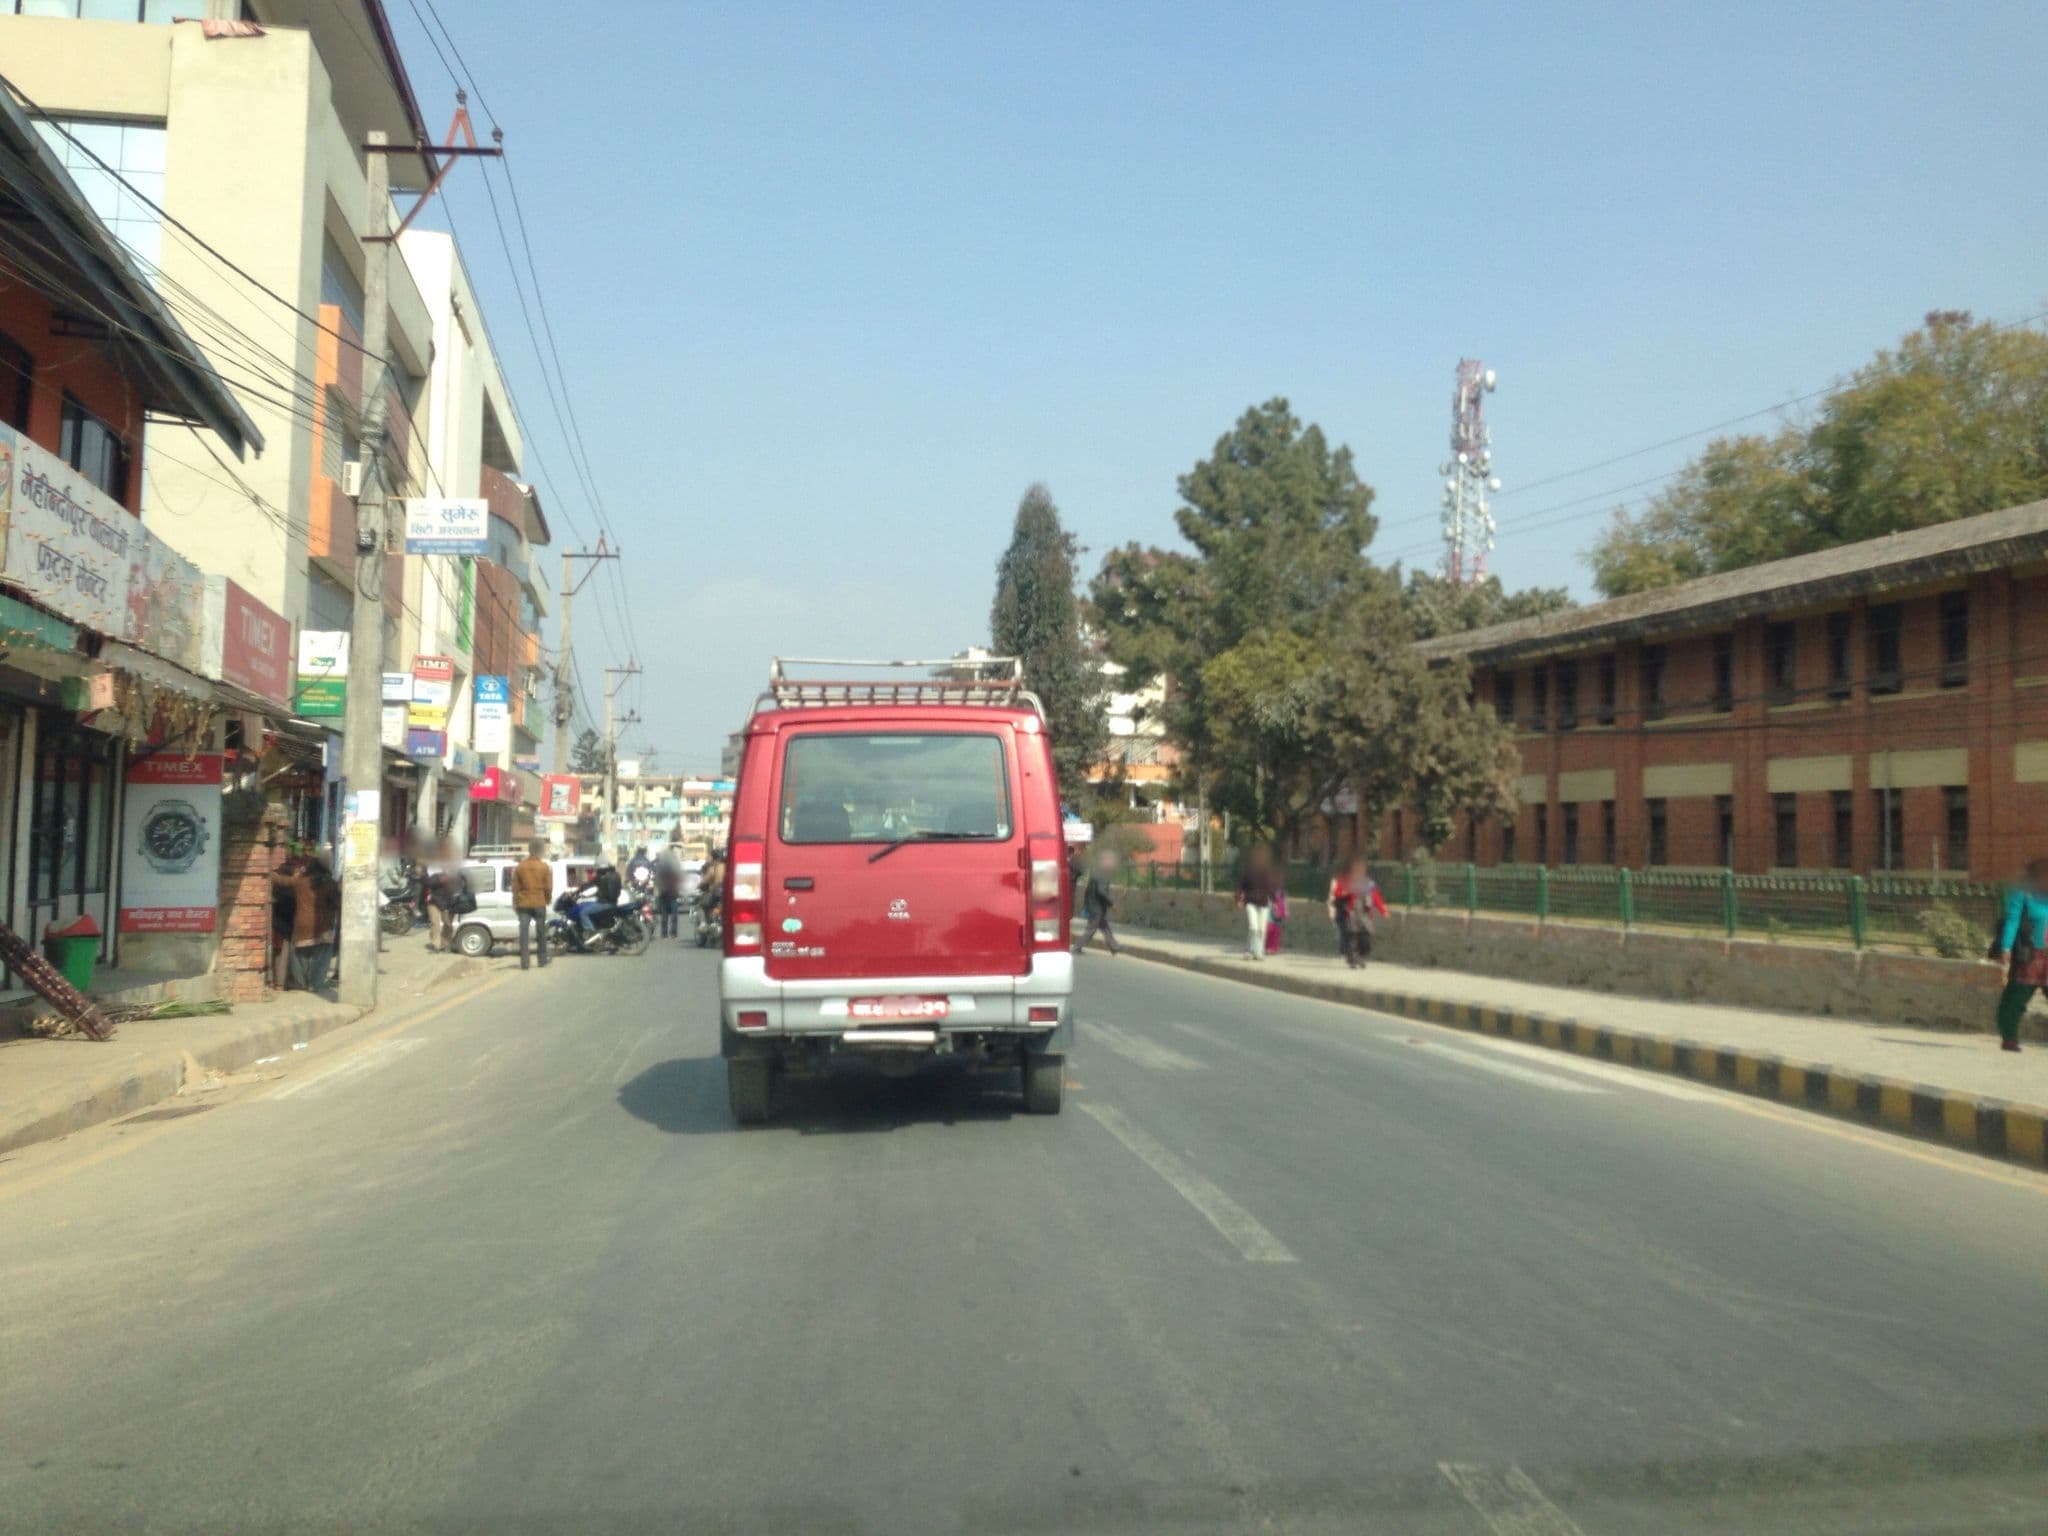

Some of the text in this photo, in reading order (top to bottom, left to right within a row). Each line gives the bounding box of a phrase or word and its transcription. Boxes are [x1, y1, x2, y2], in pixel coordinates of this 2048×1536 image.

[479, 692, 503, 700] TATA
[415, 746, 436, 754] ATM
[144, 760, 203, 773] TIMEX
